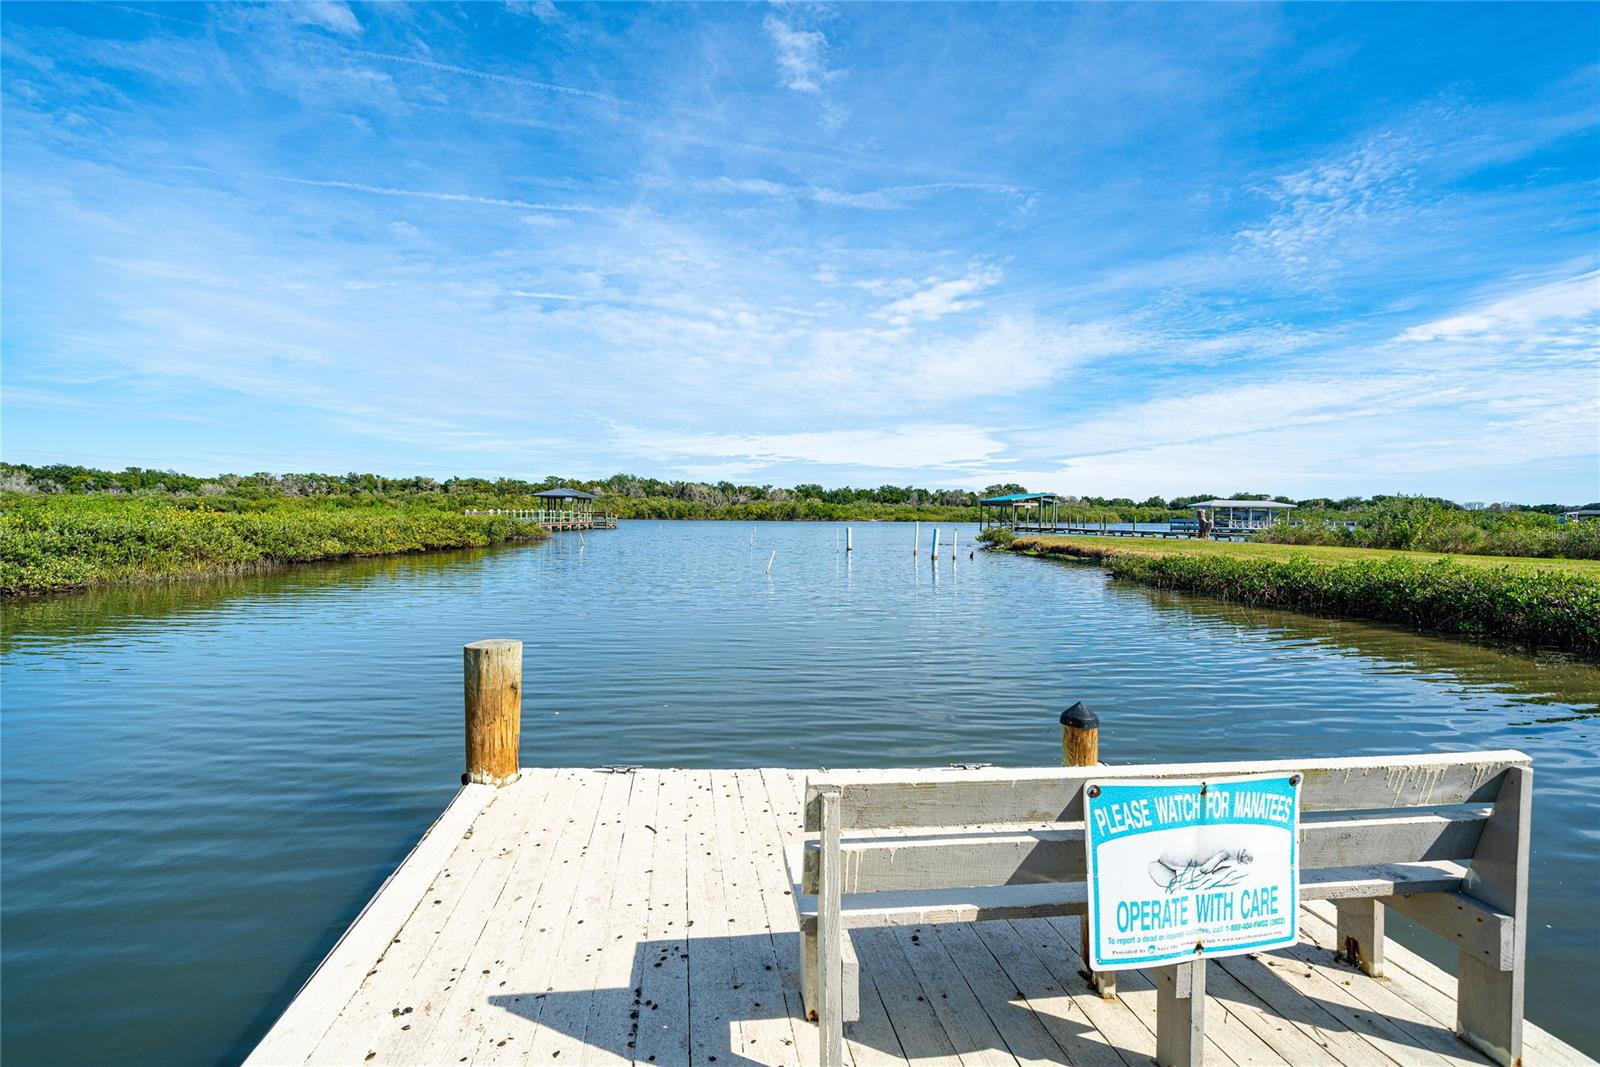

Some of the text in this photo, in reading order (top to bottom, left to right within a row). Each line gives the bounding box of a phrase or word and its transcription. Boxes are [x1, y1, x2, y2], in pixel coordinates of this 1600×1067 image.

[1094, 791, 1293, 837] PLEASE WATCH FOR MANATEES
[1116, 885, 1279, 933] OPERATE WITH CARE
[1108, 937, 1116, 945] To
[1116, 936, 1136, 946] report
[1142, 934, 1157, 942] dead
[1213, 925, 1224, 934] call
